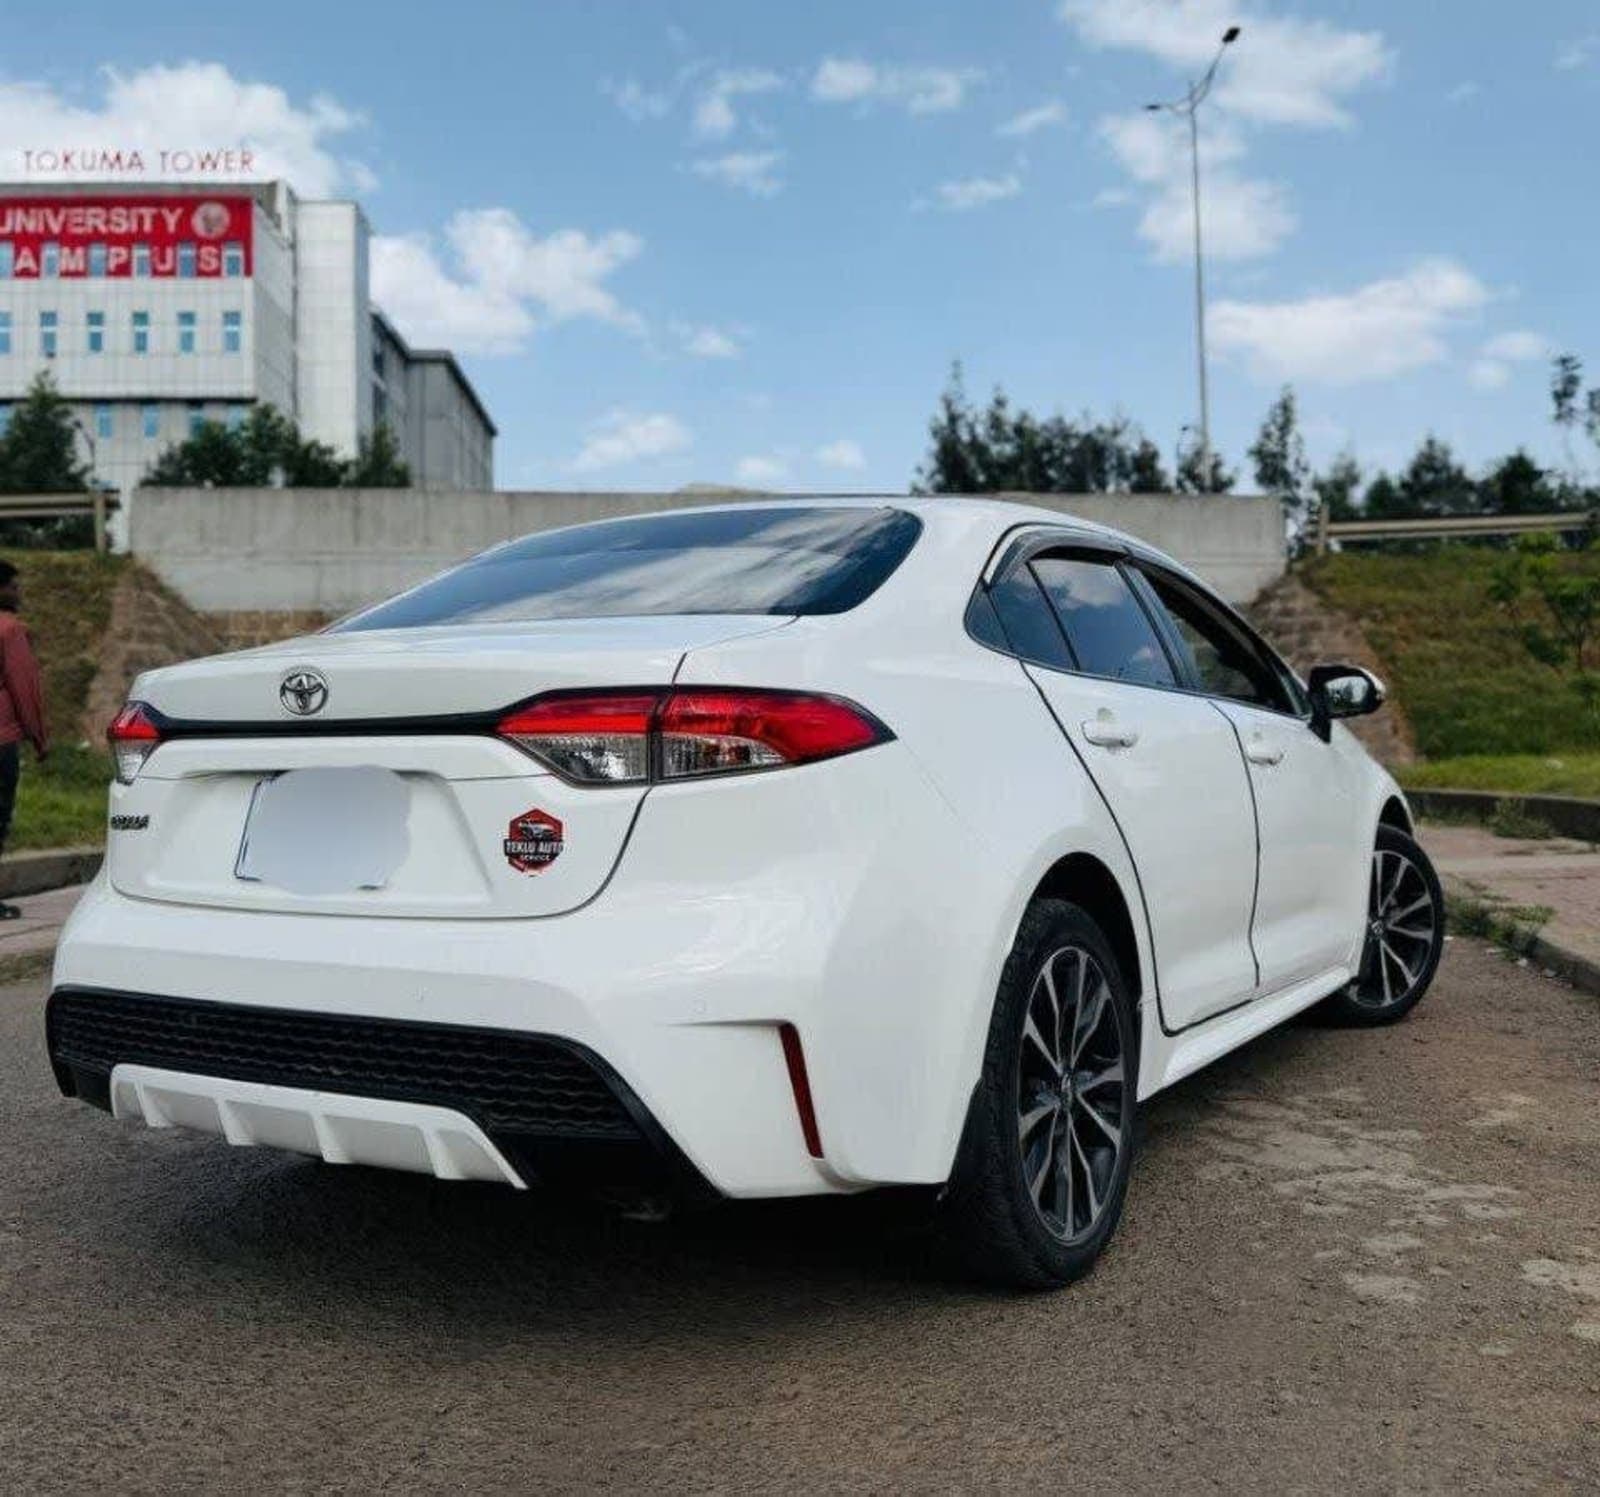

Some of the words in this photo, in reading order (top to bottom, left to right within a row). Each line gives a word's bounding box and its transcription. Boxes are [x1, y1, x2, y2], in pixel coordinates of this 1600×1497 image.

[23, 150, 145, 173] TOKUMA
[159, 150, 255, 173] TOWER
[538, 840, 565, 854] AUTO
